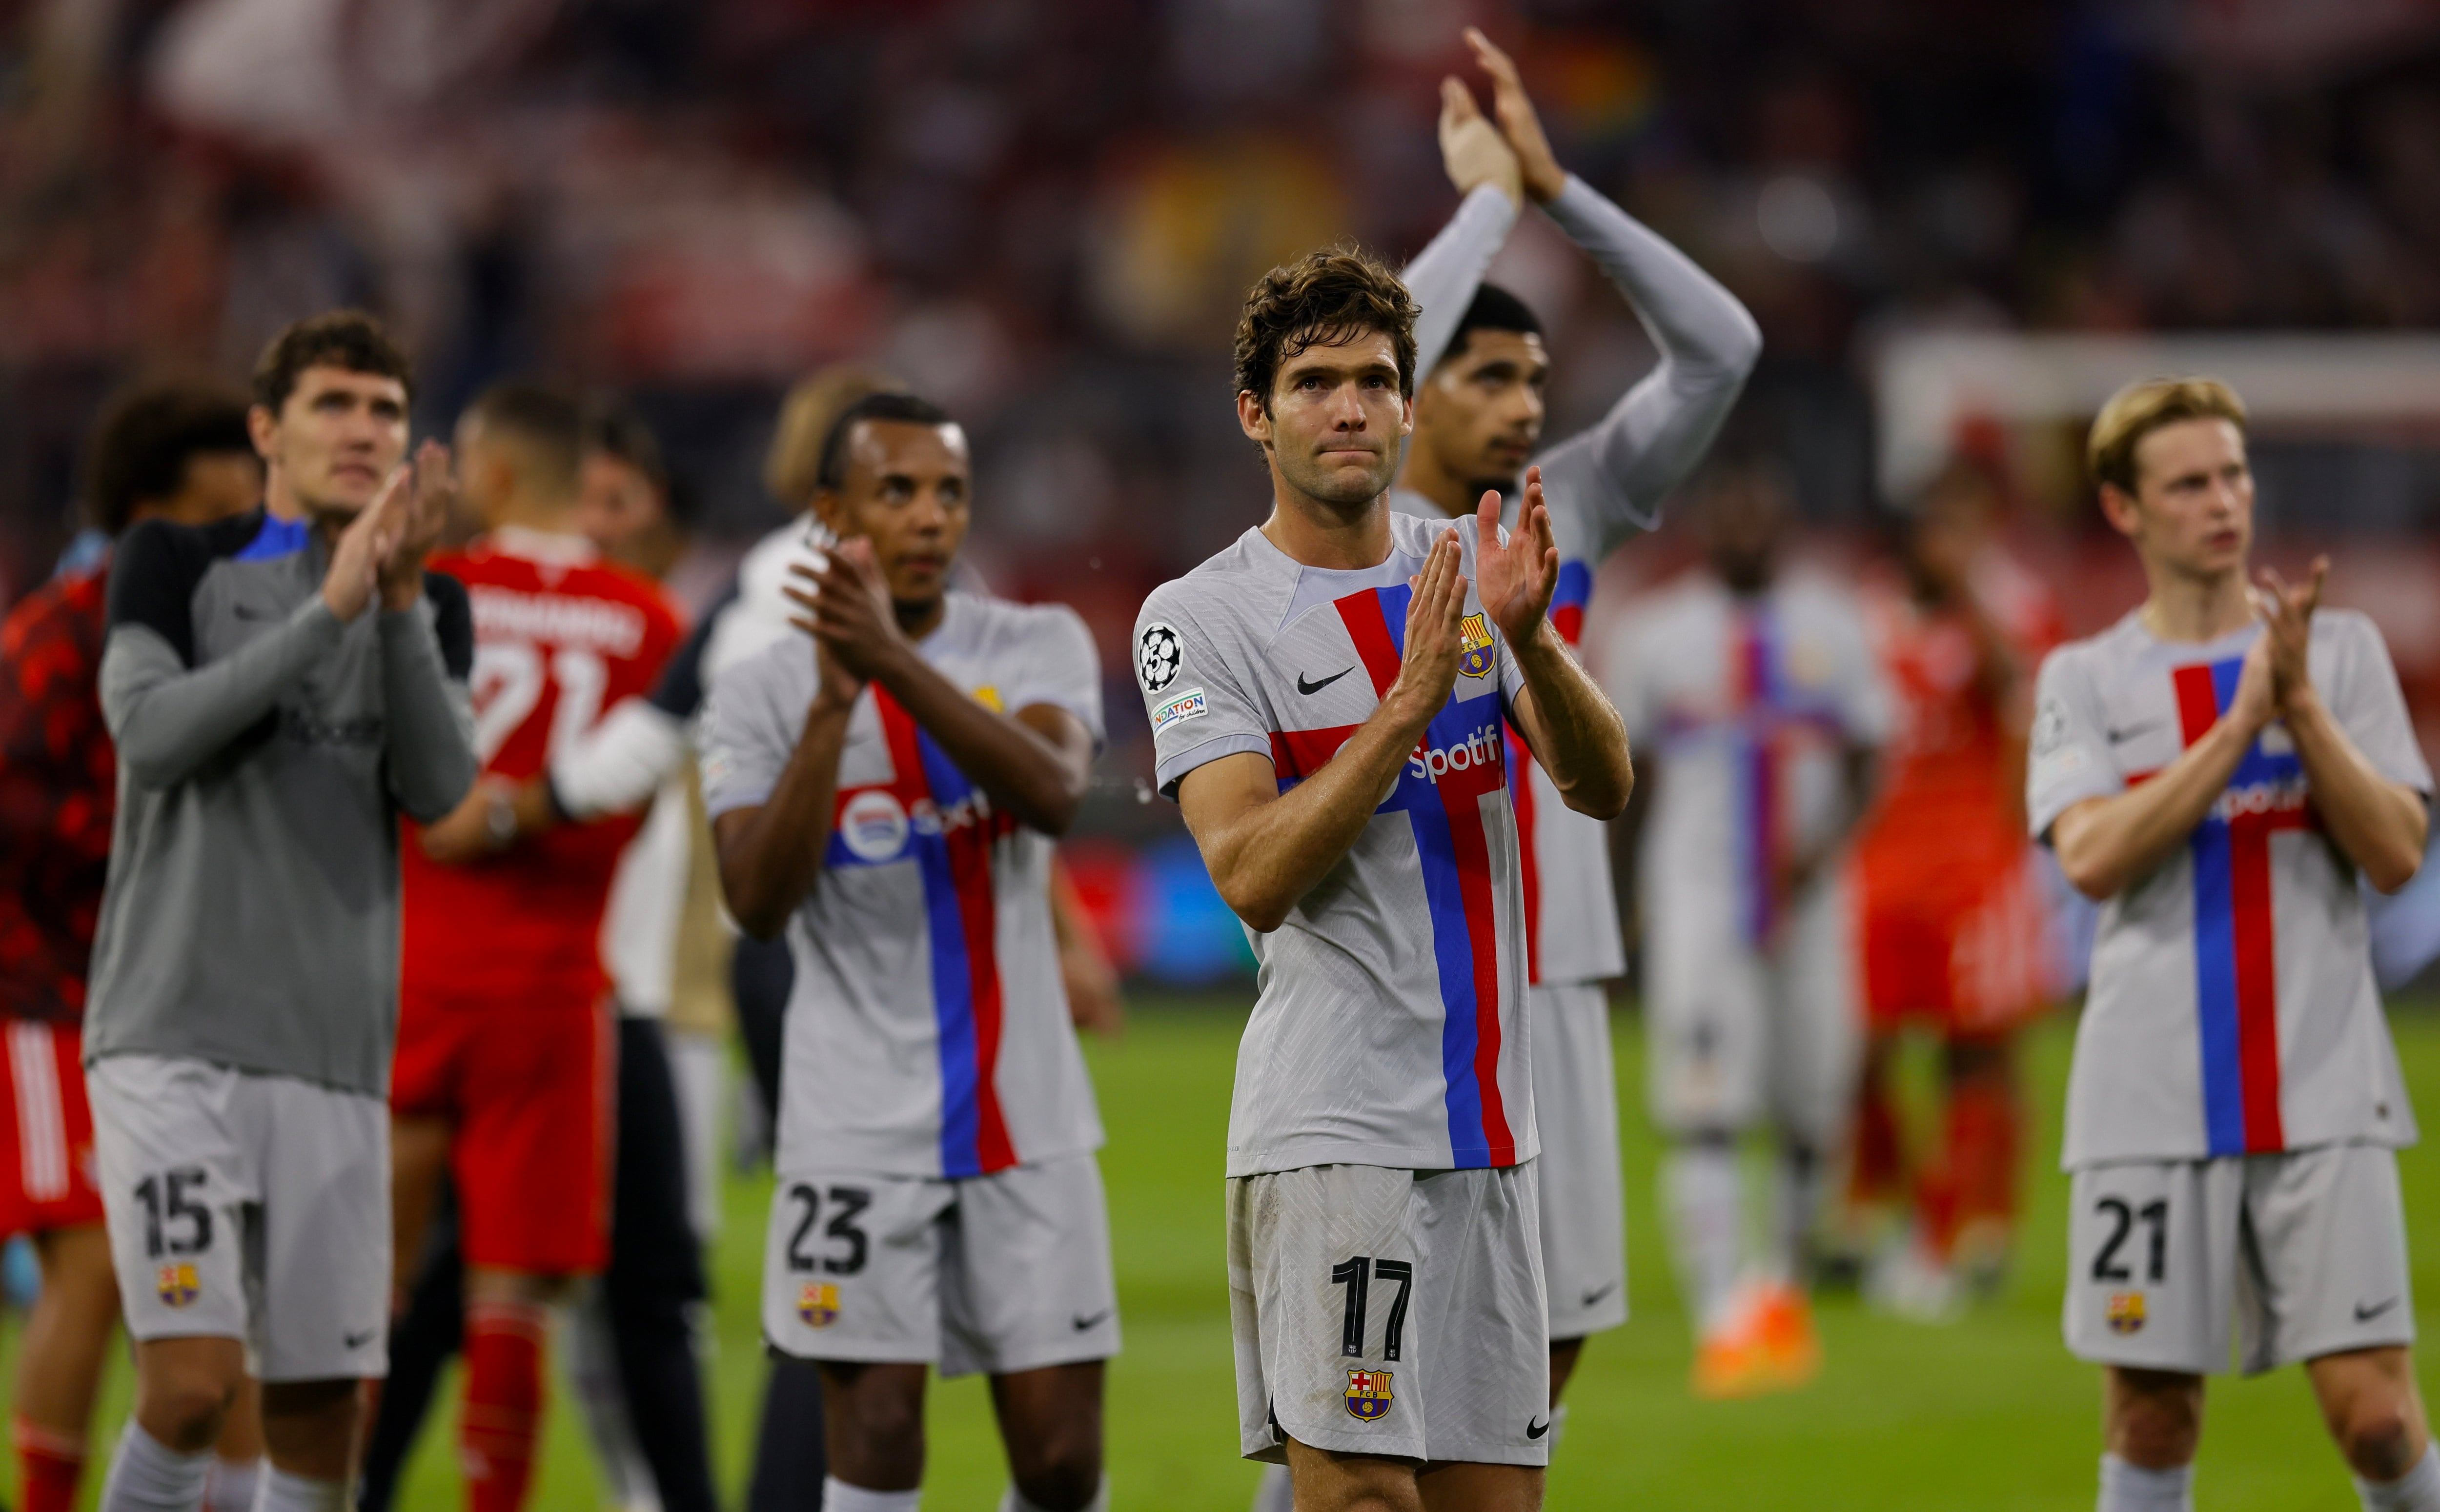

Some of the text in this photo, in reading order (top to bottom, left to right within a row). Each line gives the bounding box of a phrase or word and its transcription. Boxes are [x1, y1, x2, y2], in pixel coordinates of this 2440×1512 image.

[1149, 644, 1161, 673] 5
[1186, 708, 1205, 717] children
[135, 1169, 213, 1258] 15
[788, 1183, 871, 1276] 23
[2092, 1197, 2167, 1282] 21
[1332, 1256, 1412, 1362] 17
